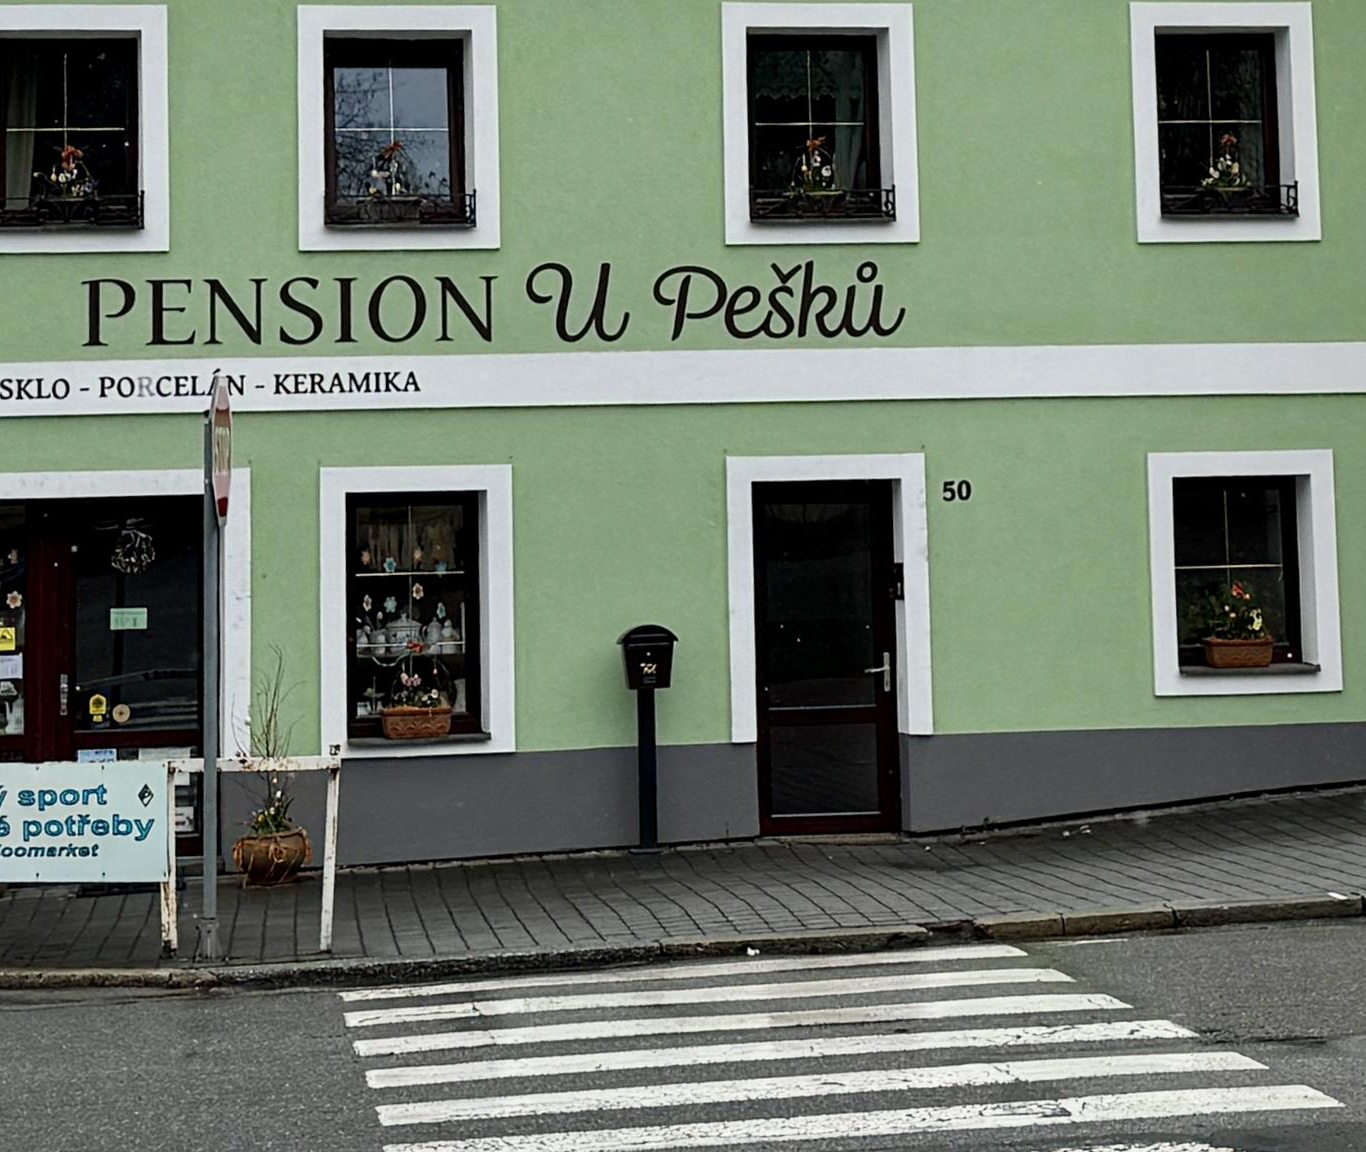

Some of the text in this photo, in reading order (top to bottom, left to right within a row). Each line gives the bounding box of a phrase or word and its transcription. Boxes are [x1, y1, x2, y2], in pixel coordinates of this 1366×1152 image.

[81, 260, 906, 347] PENSION U Pešků
[273, 371, 421, 395] KERAMIKA
[942, 479, 972, 501] 50
[17, 783, 108, 810] sport
[22, 813, 155, 842] potřeby
